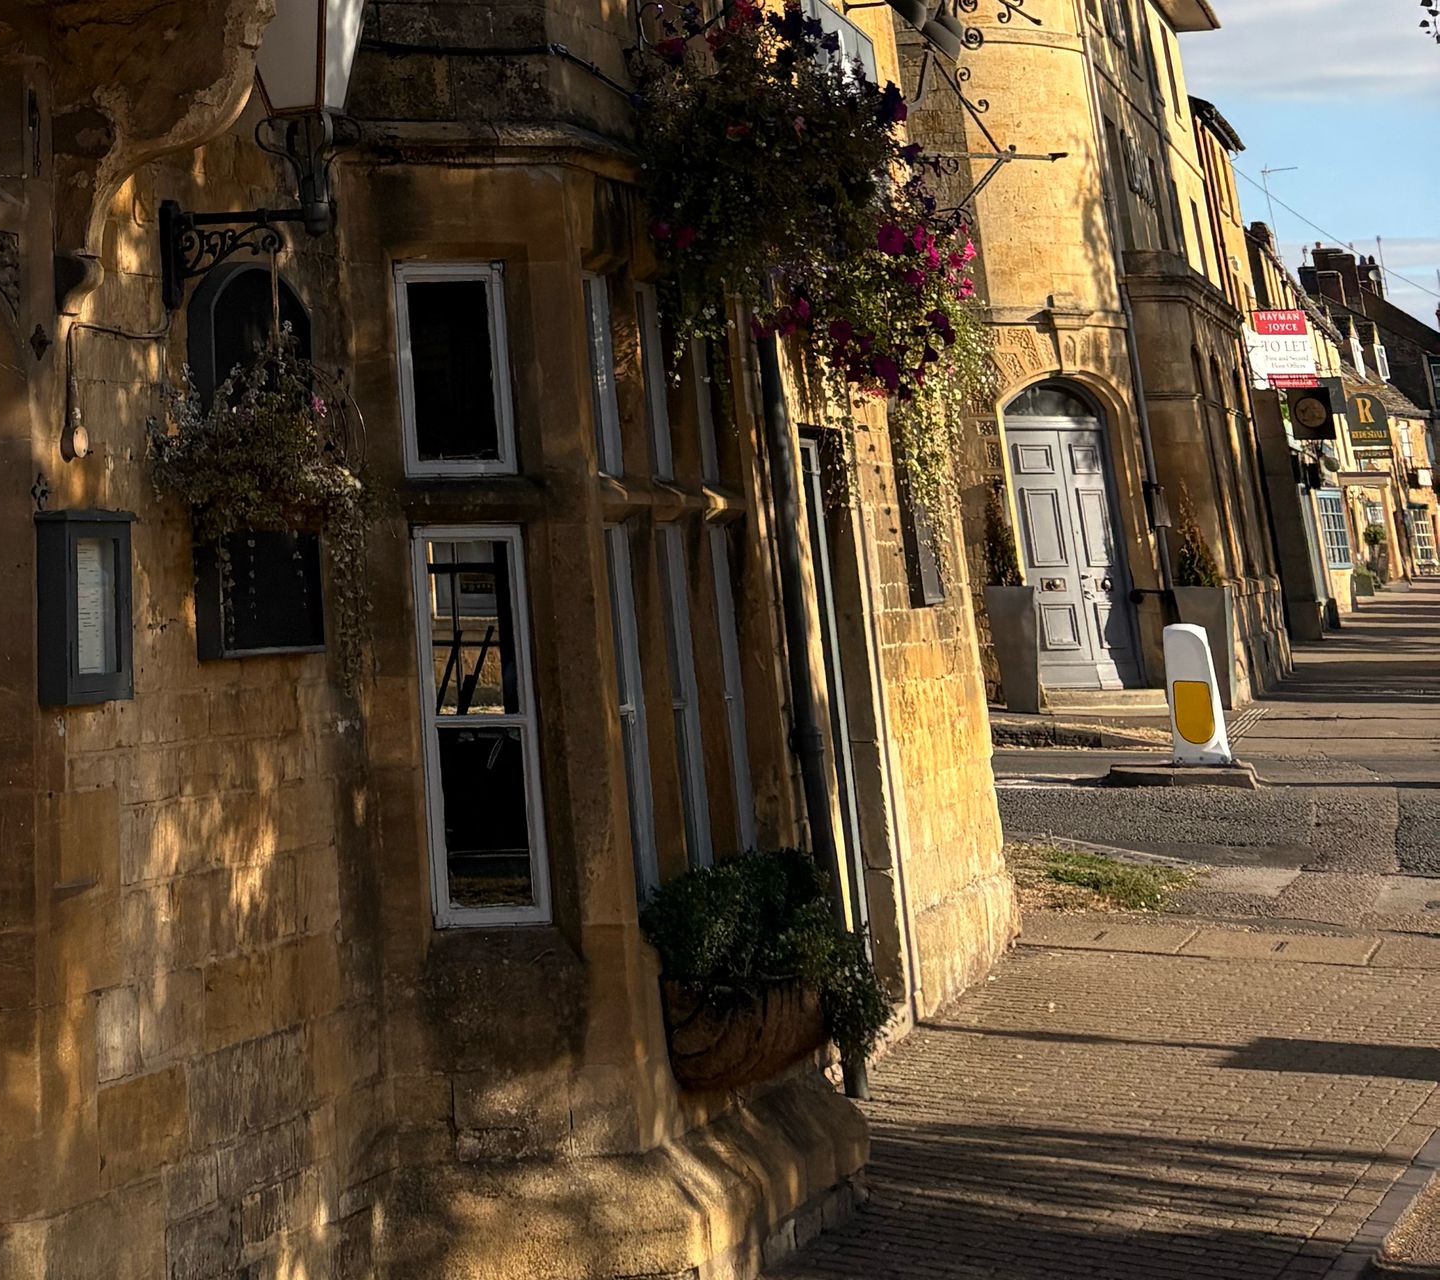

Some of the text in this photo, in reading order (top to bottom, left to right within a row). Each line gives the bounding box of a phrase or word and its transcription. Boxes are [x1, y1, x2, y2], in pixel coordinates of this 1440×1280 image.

[1258, 312, 1299, 321] HAYMAN
[1262, 340, 1308, 352] TO LET
[1356, 397, 1374, 423] R
